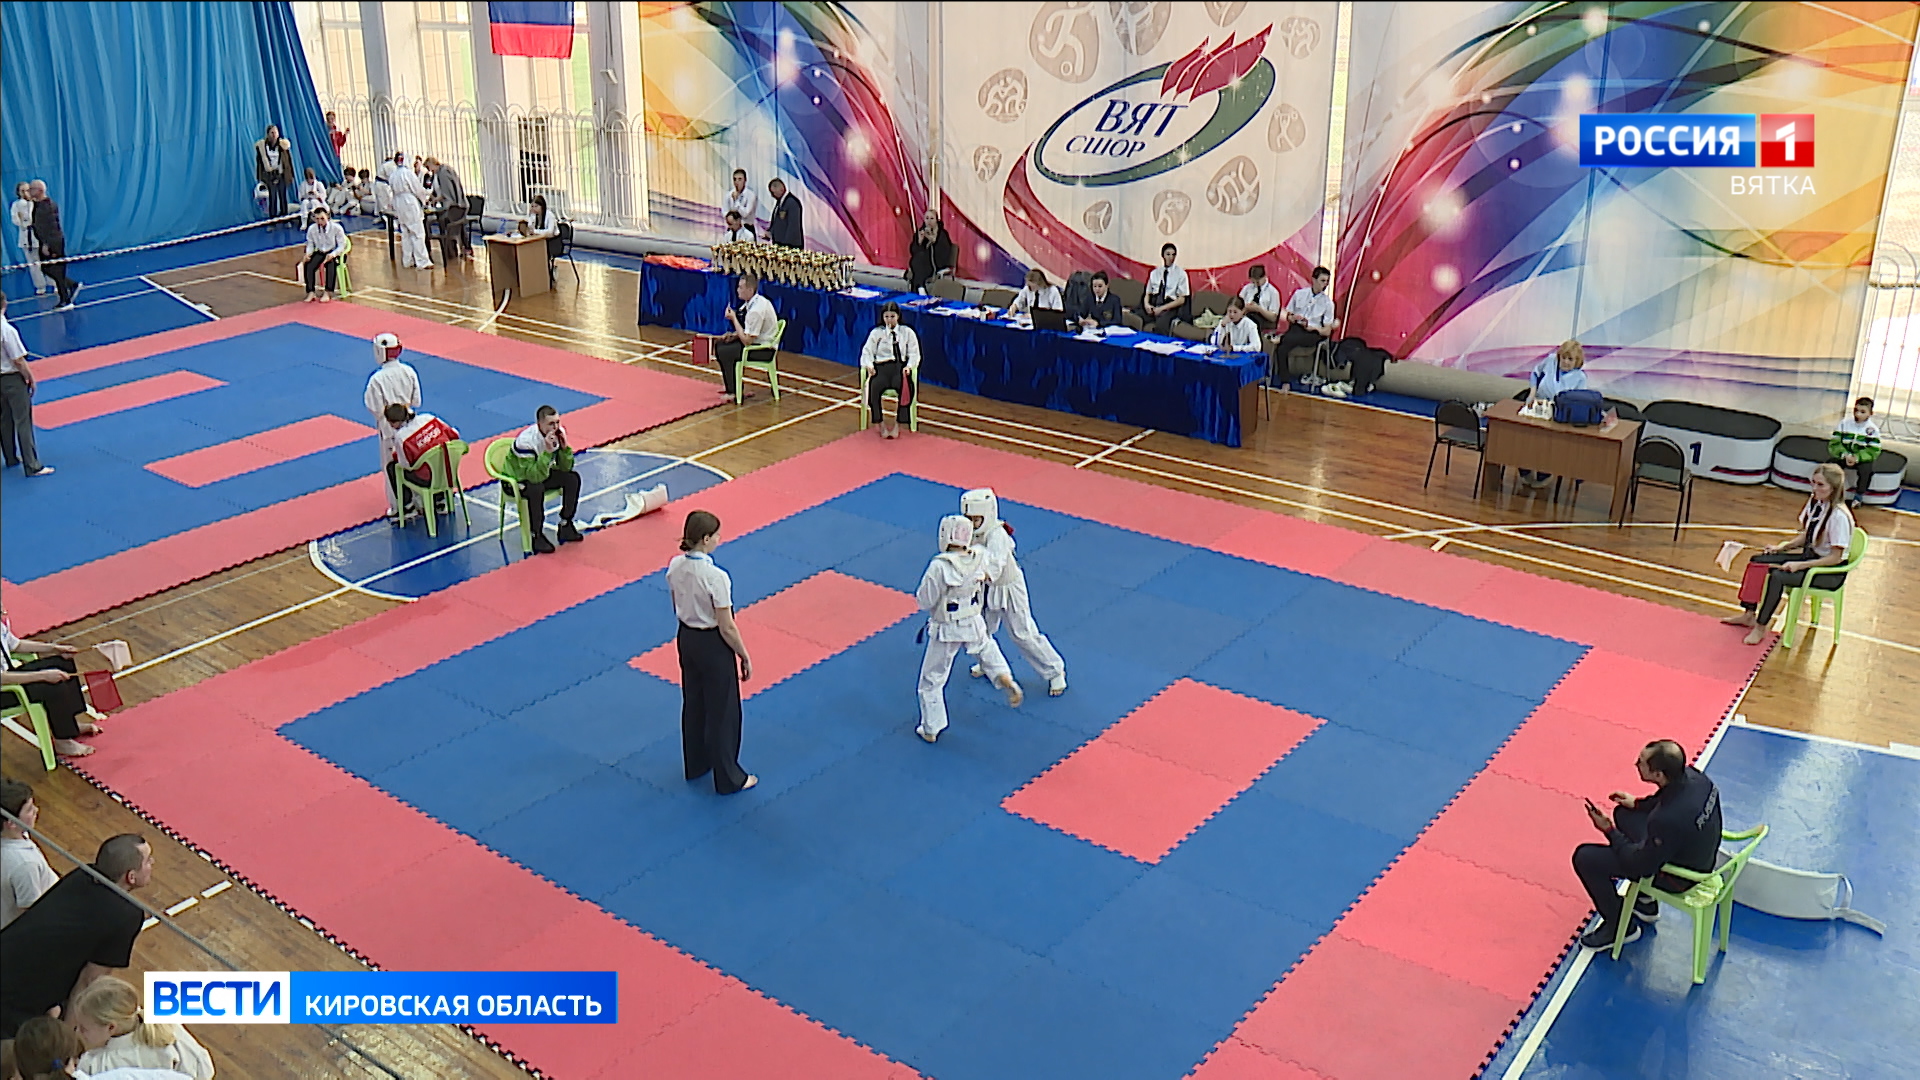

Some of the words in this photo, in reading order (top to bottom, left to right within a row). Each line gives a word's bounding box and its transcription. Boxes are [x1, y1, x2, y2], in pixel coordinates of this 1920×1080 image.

[1095, 99, 1188, 138] ВЯТ
[1066, 135, 1146, 158] СШОР
[1690, 441, 1702, 465] 1
